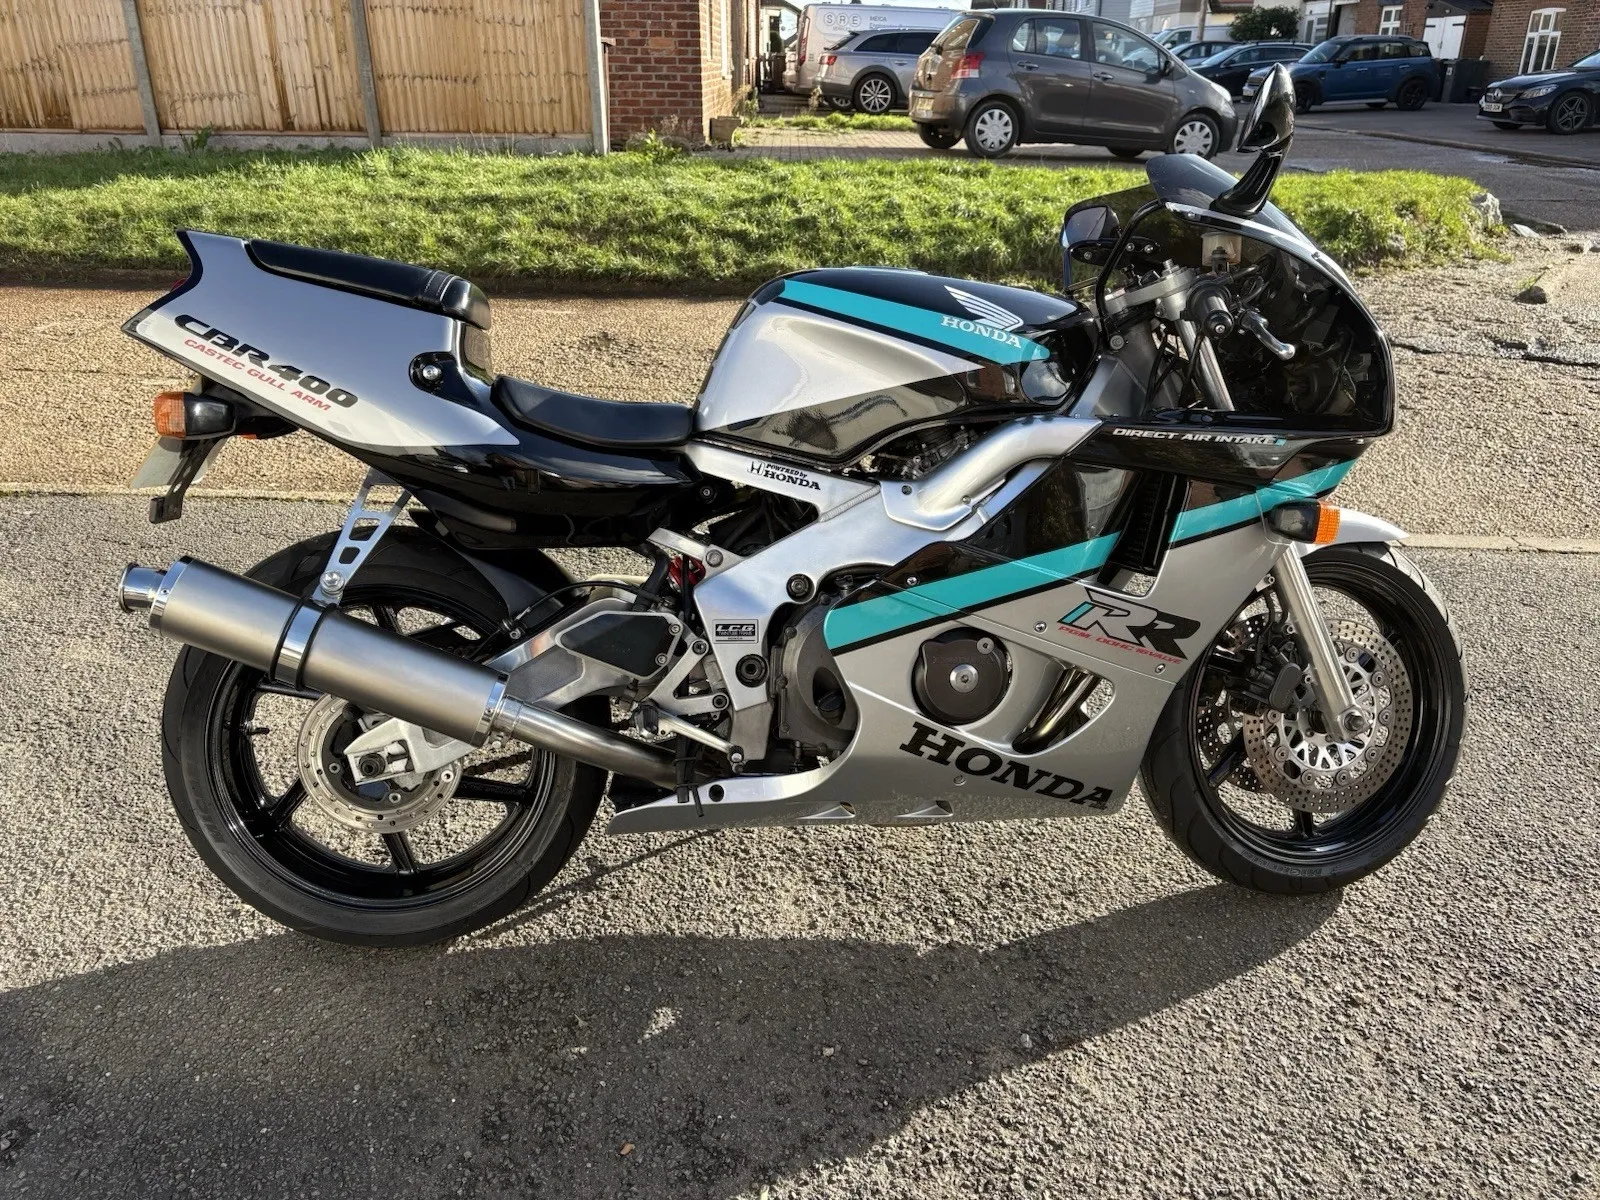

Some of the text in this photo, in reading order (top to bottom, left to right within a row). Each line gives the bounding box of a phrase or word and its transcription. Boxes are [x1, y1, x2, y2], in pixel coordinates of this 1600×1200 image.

[941, 315, 1022, 349] HONDA
[174, 314, 359, 408] CBR400
[184, 338, 332, 412] CASTEC GULL ARM
[1112, 428, 1277, 446] DIRECT AIR INTAKE
[763, 470, 821, 491] HONDA
[766, 463, 808, 479] POWERED by
[1058, 625, 1091, 640] PGM
[1096, 636, 1135, 652] DOHC
[899, 721, 1114, 811] HONDA
